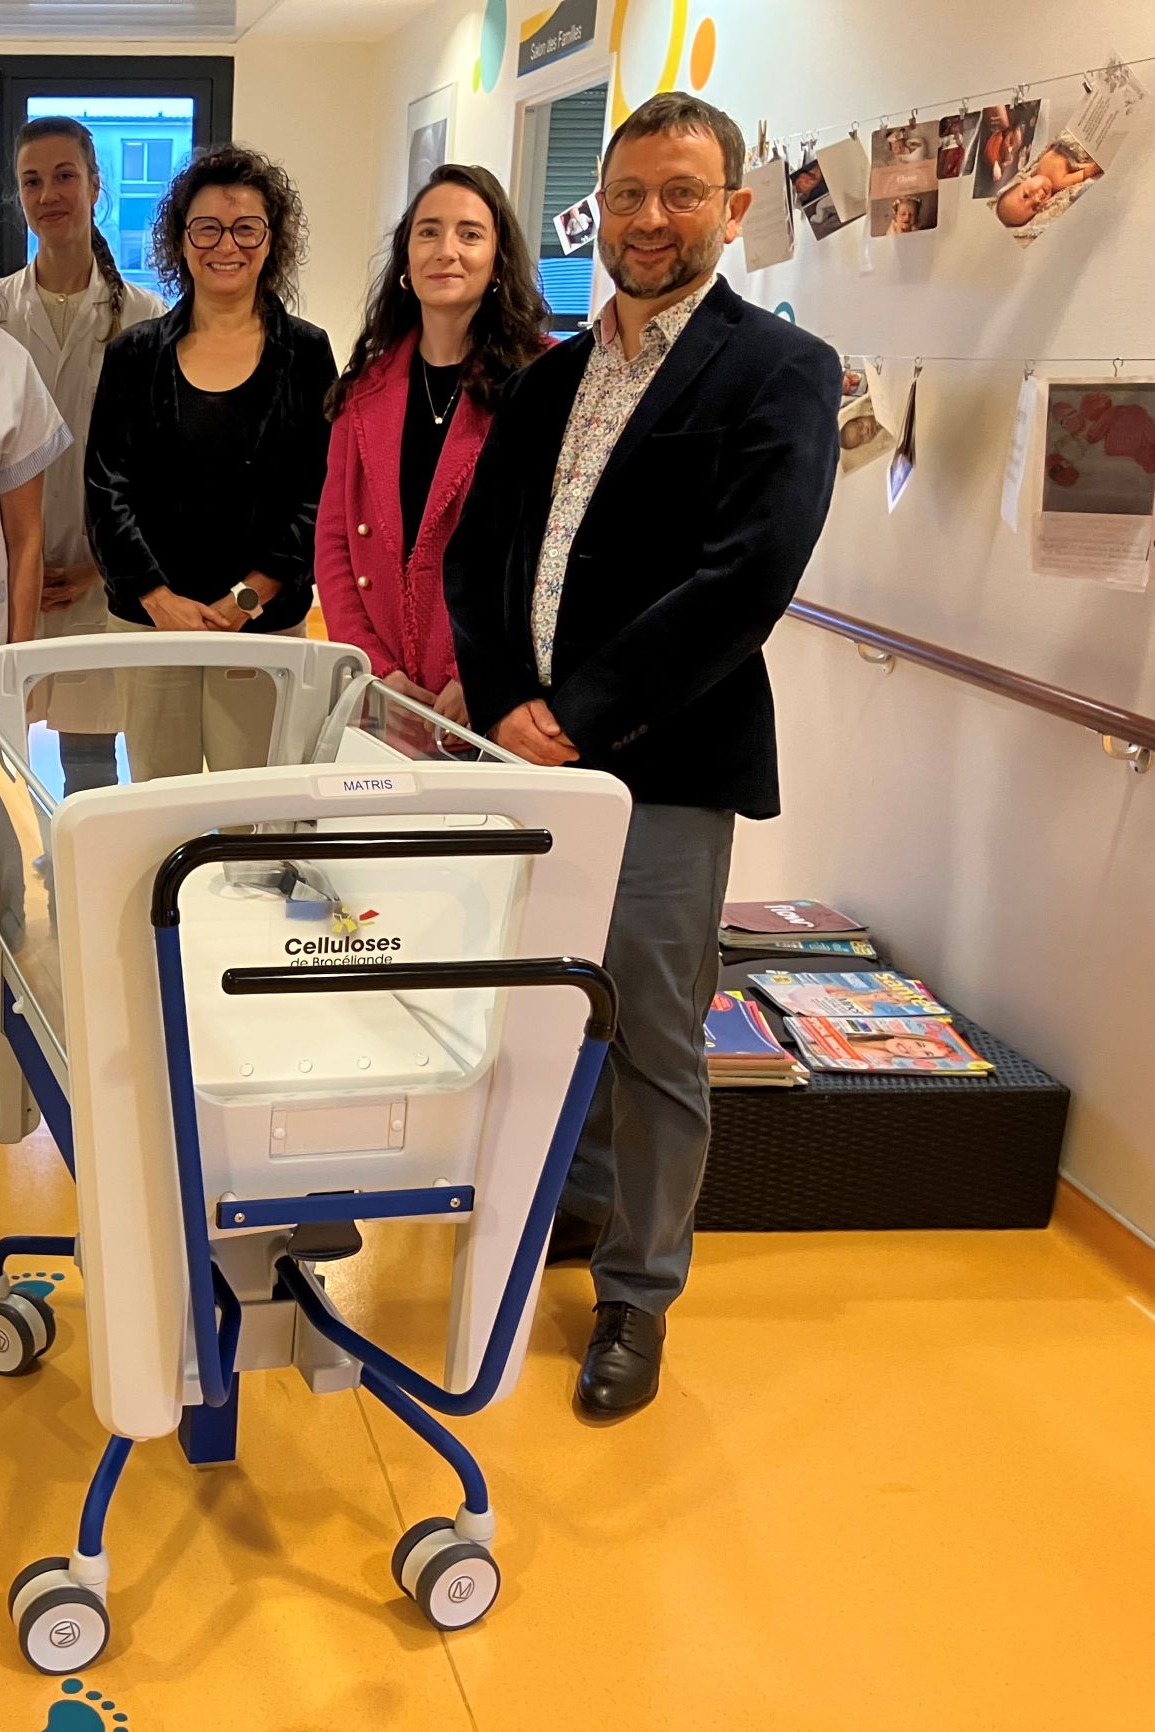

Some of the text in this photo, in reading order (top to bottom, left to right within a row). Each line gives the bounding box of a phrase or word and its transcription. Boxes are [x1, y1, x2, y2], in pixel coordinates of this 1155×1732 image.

[530, 24, 582, 60] Salon des Familles
[343, 779, 393, 792] MATRIS
[284, 935, 402, 956] Celluloses
[290, 954, 394, 967] de Brocéliande
